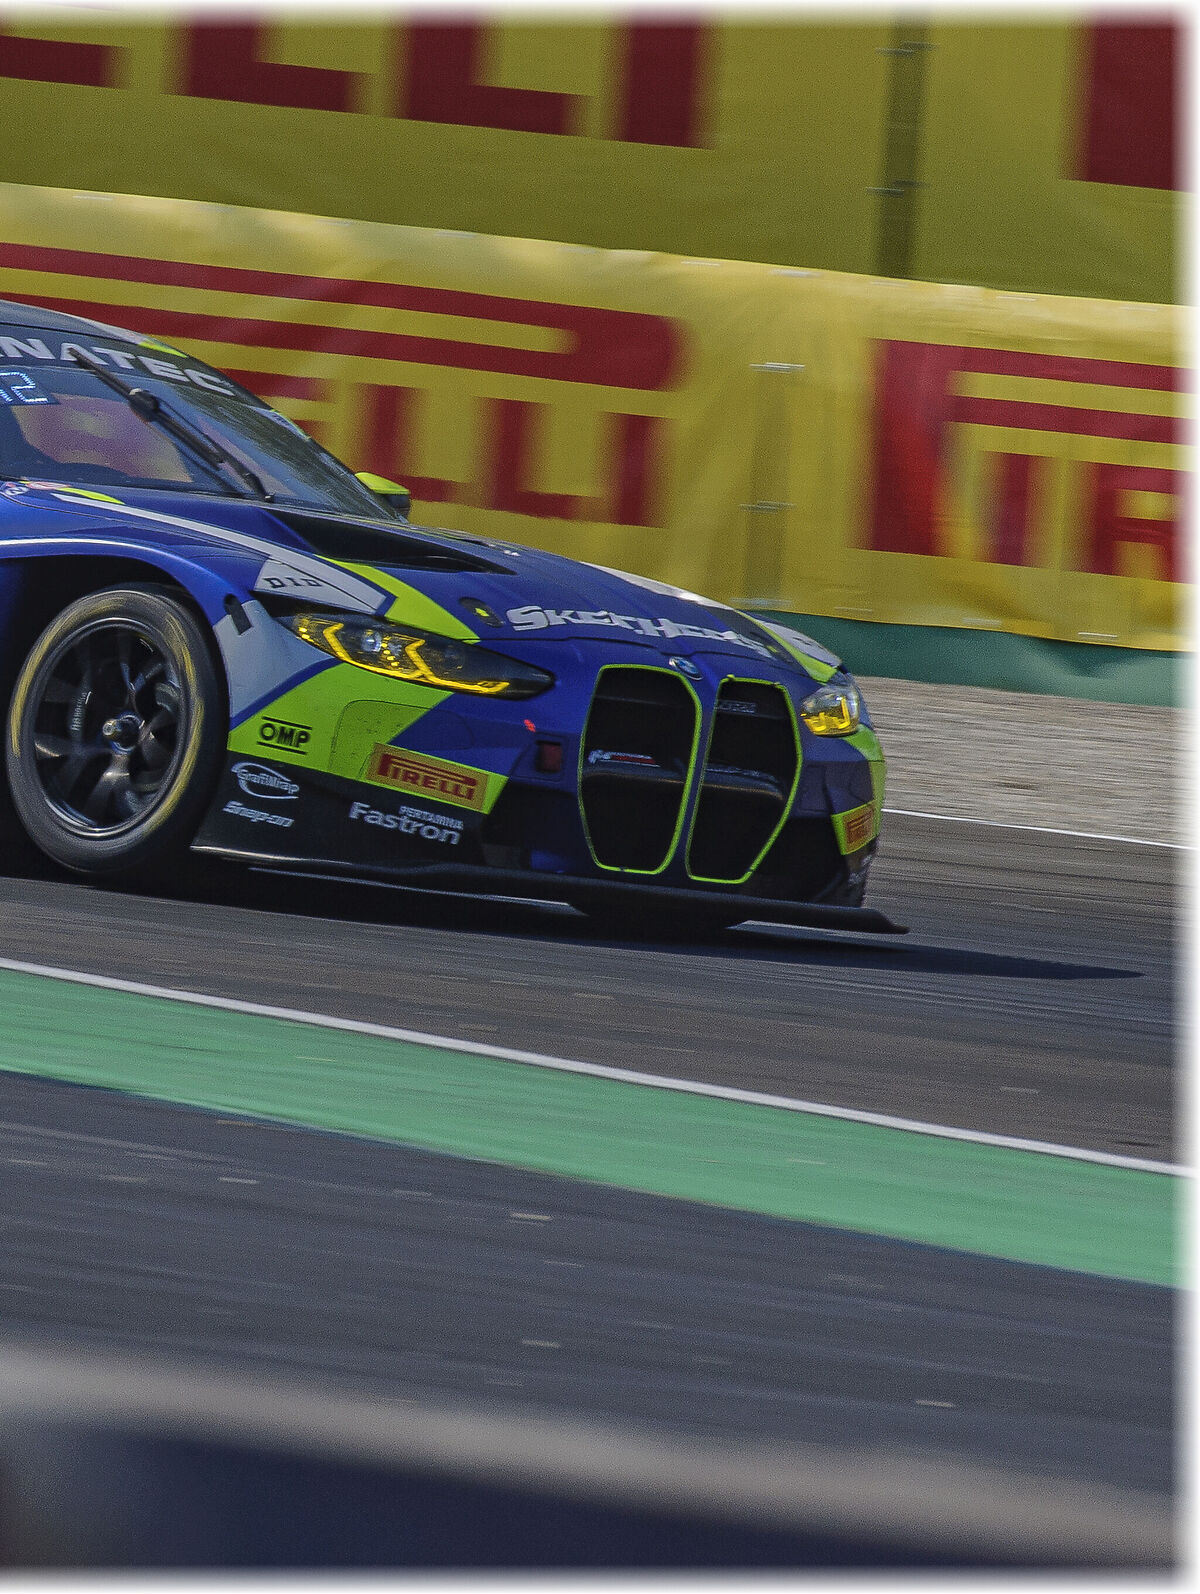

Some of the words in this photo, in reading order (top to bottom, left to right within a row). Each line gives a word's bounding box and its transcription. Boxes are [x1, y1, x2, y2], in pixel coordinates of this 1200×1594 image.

[259, 722, 310, 747] OMP
[377, 753, 477, 801] PIRELLI
[349, 801, 461, 845] Fastron
